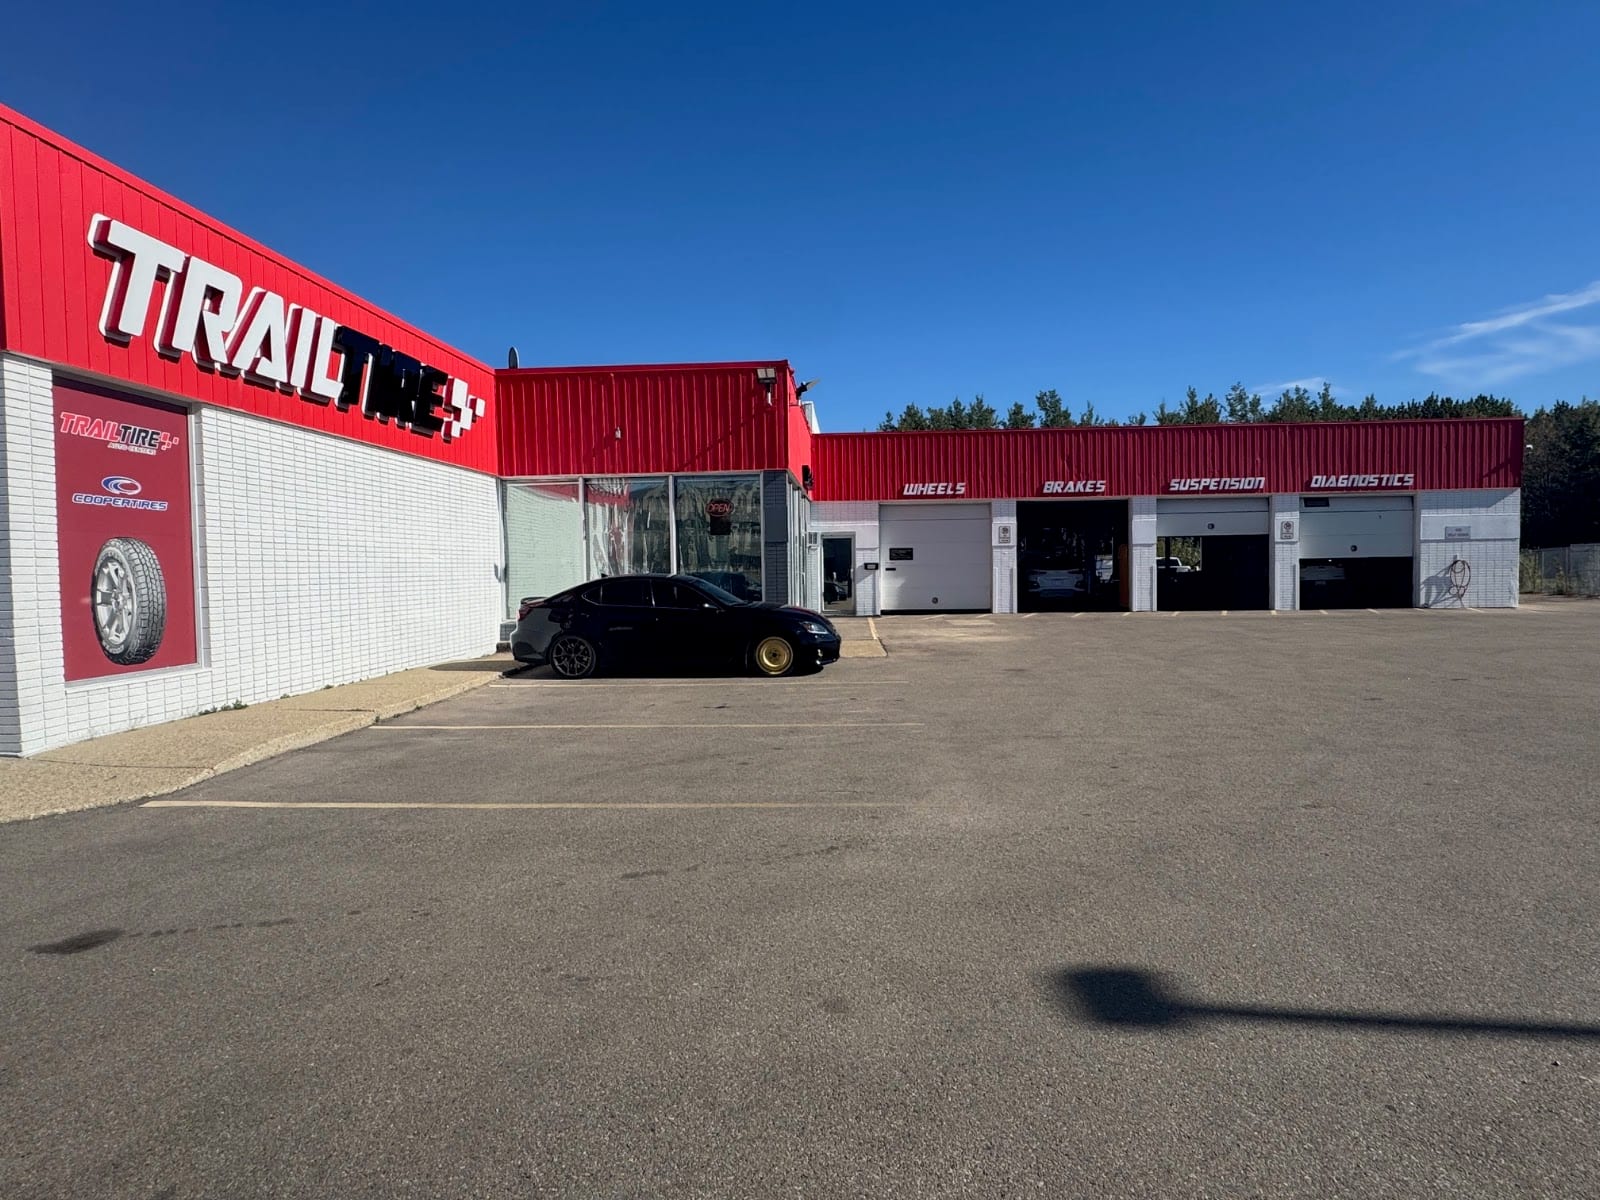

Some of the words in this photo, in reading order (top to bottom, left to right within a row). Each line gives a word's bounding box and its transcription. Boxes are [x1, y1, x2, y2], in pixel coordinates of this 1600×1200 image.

[1043, 480, 1107, 494] BRAKES
[1169, 477, 1266, 491] SUSPENSION
[1310, 473, 1415, 488] DIAGNOSTICS
[903, 482, 966, 496] WHEELS
[707, 503, 731, 513] OPEN
